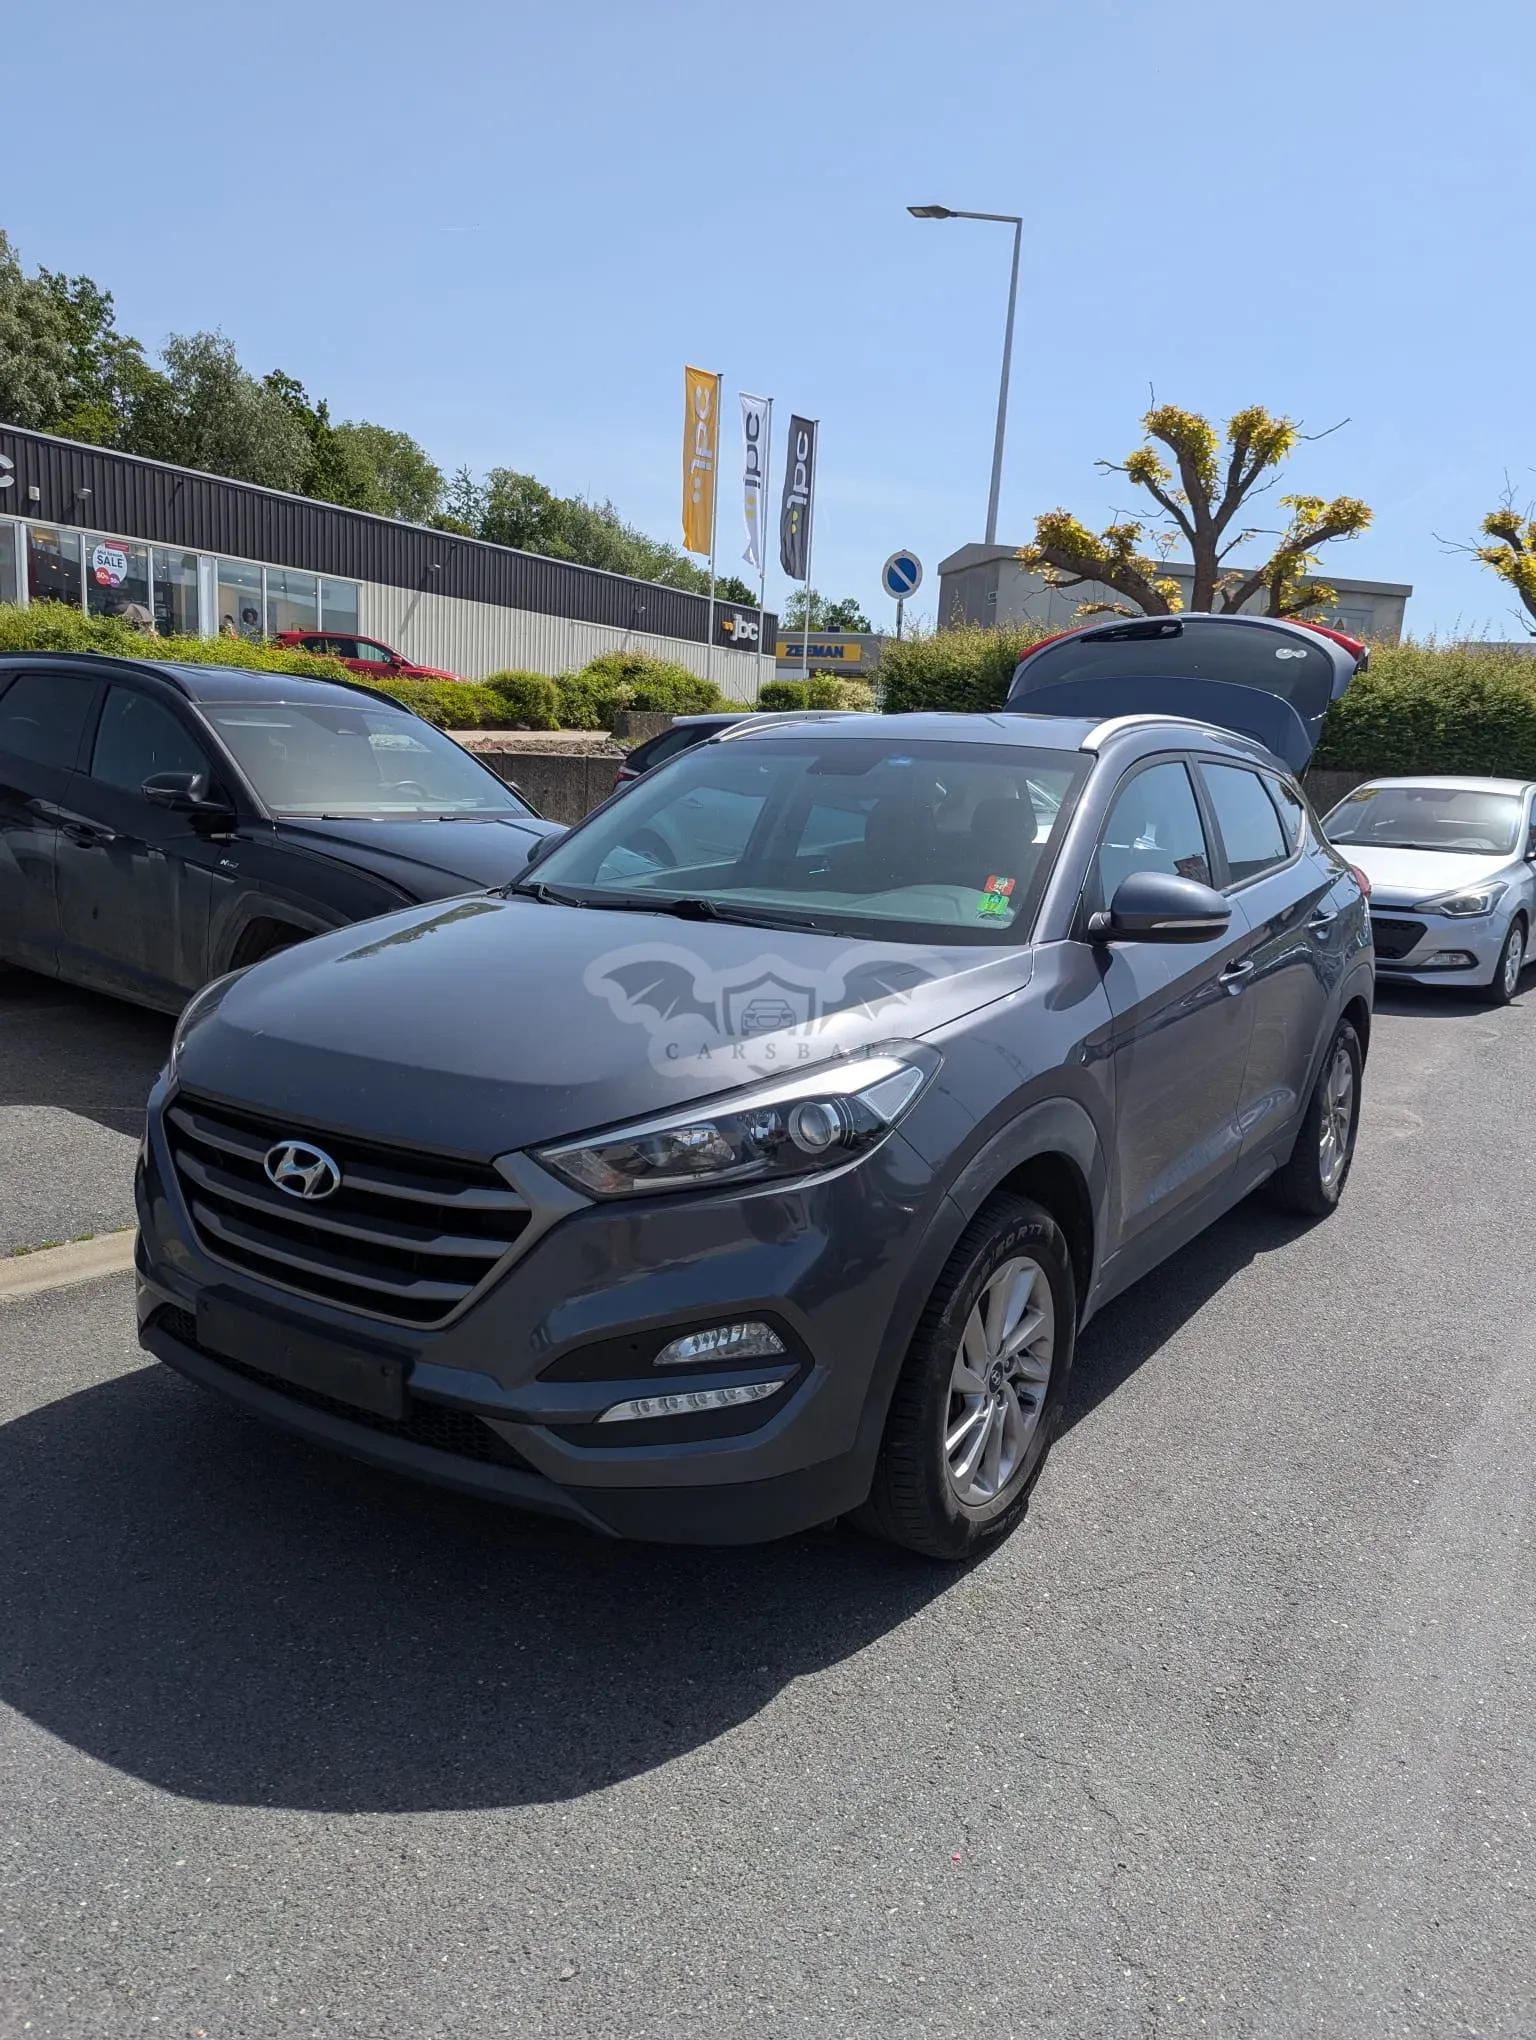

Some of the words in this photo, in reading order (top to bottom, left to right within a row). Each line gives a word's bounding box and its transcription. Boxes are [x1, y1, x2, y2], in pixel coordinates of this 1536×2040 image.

[97, 555, 123, 568] SALE
[731, 613, 759, 641] jbc
[785, 645, 844, 658] ZEEMAN
